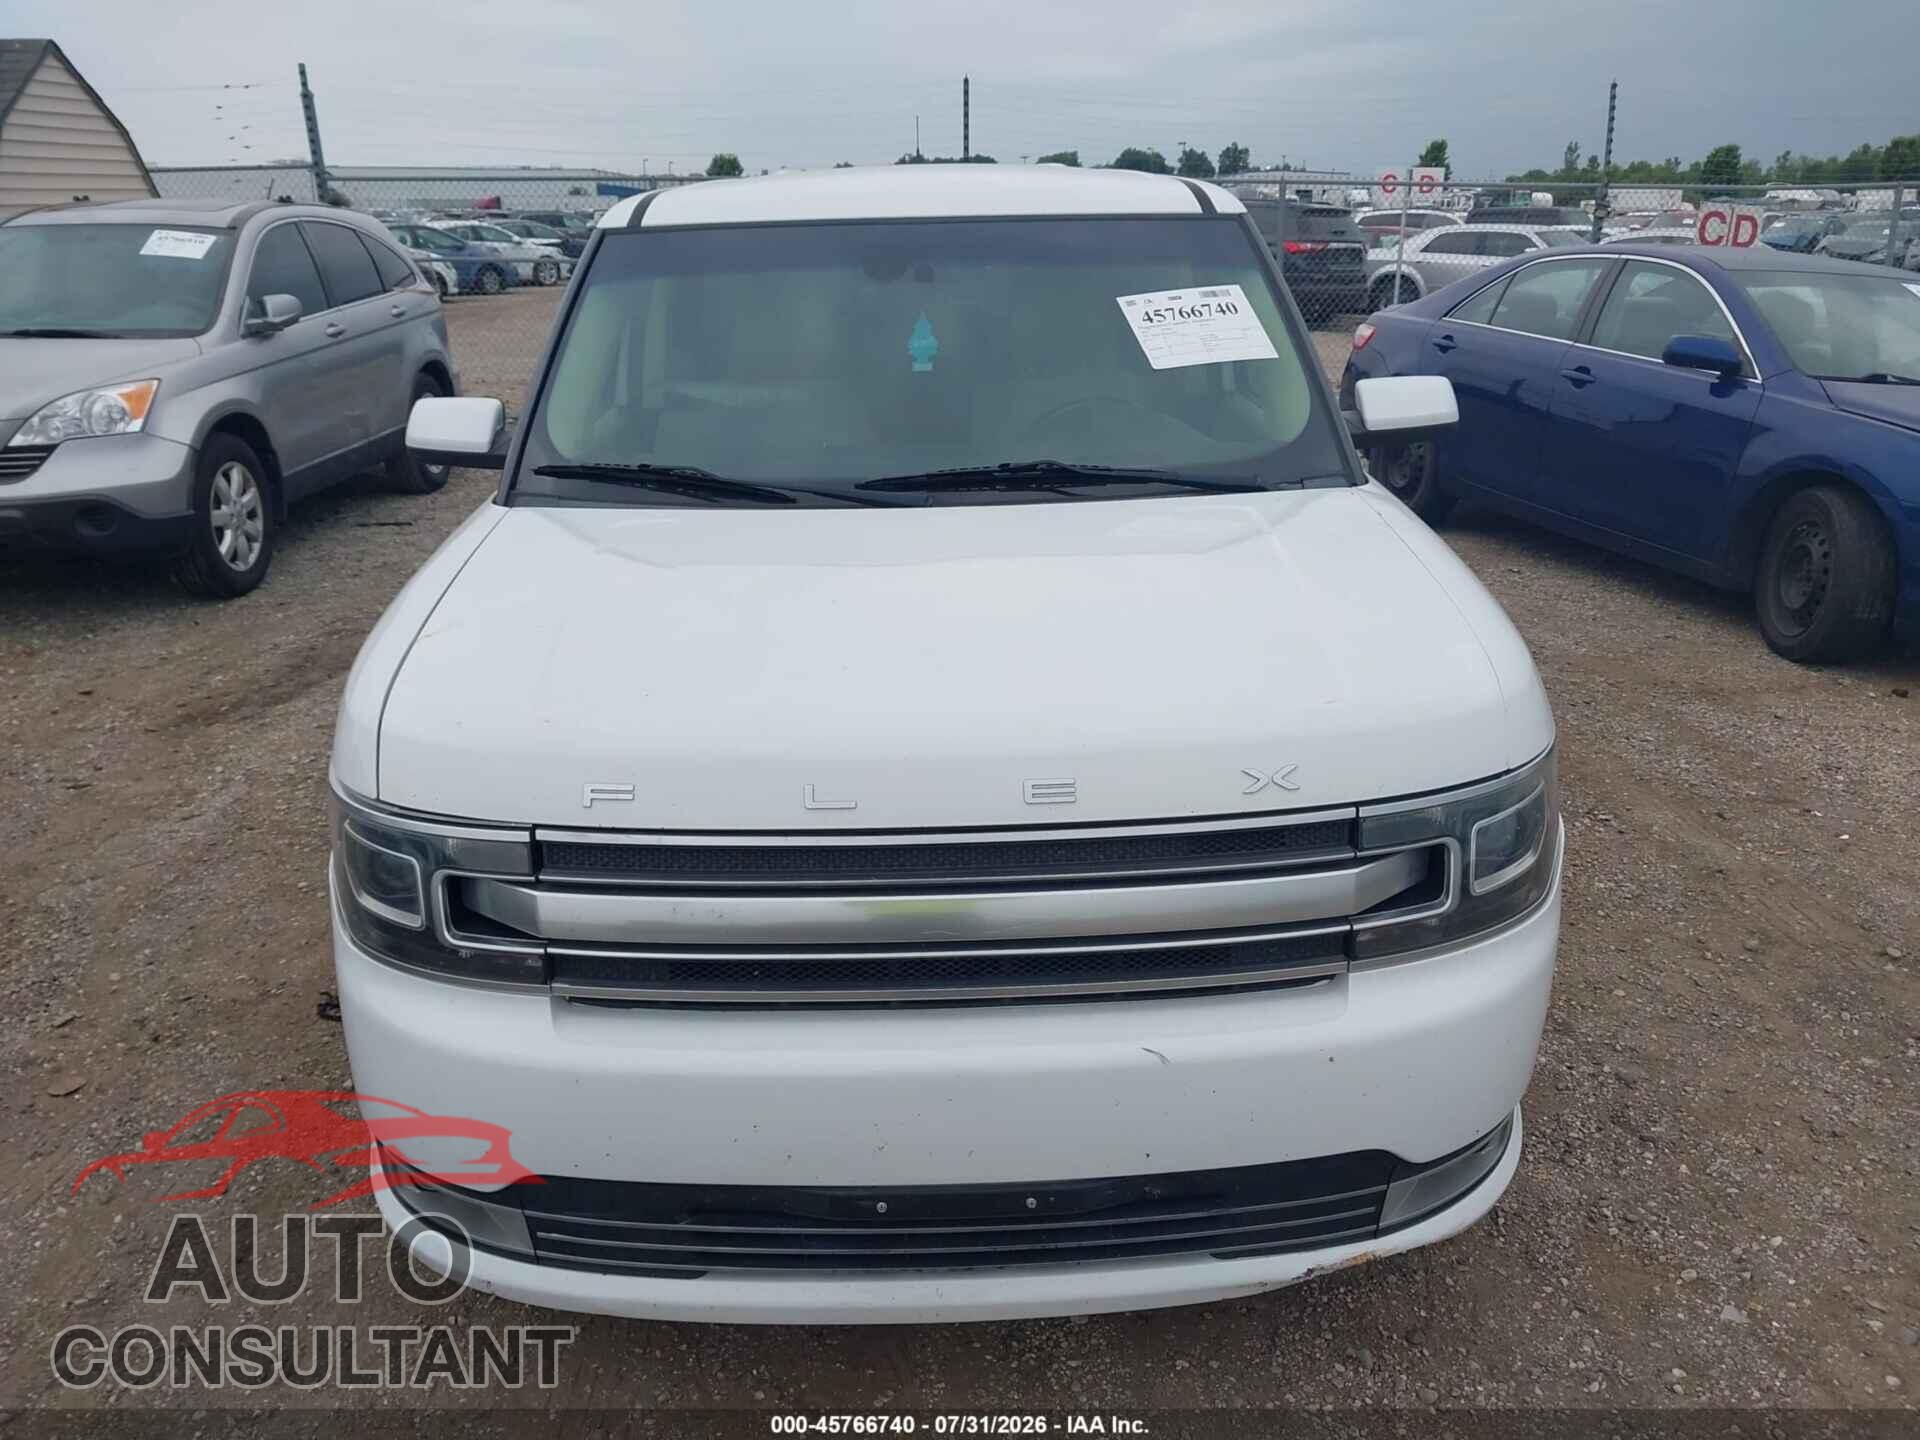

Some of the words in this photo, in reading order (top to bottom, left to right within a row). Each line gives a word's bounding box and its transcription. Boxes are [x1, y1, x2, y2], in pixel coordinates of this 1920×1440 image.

[1381, 173, 1398, 194] C
[1419, 174, 1435, 194] D
[1141, 301, 1238, 324] 45766740
